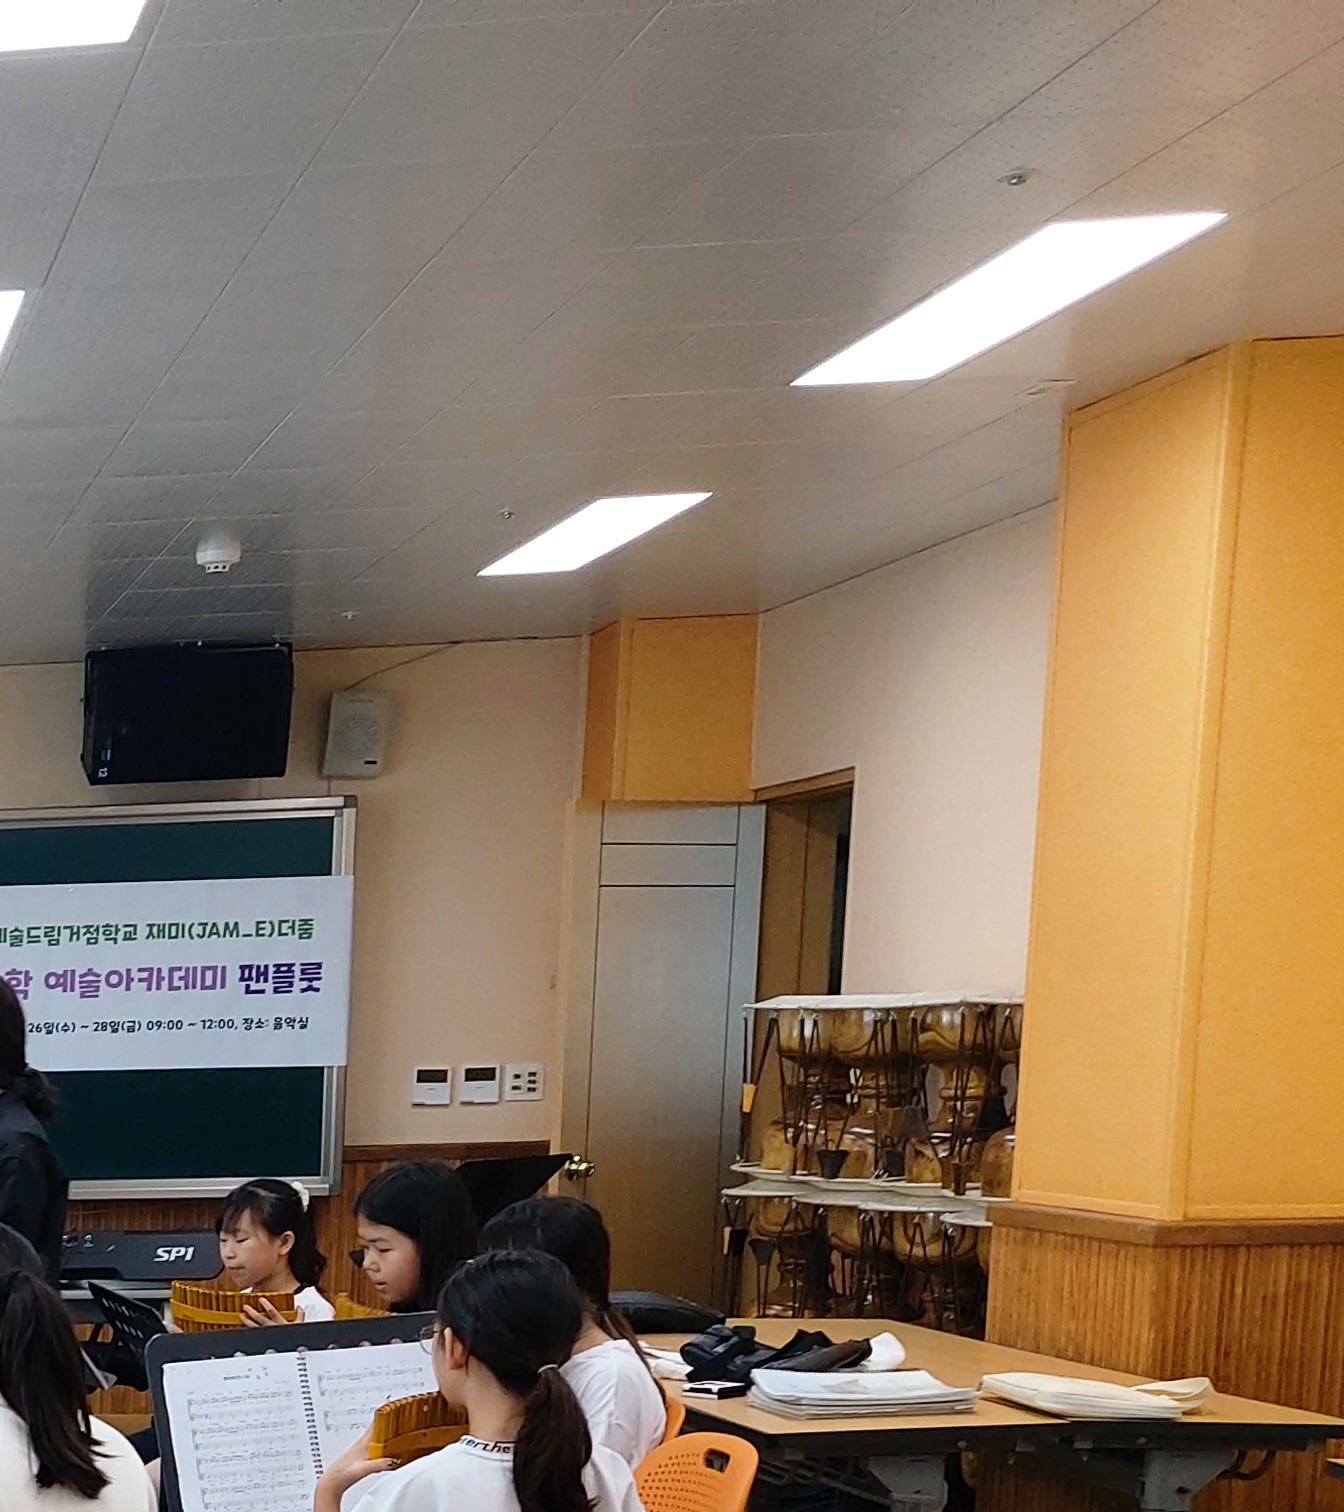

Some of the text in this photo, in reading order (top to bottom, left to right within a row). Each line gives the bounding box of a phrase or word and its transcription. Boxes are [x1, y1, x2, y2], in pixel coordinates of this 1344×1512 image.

[145, 917, 315, 941] 재미(JAM_E)더줌
[43, 965, 227, 999] 예술아카데미
[238, 961, 324, 995] 팬플룻
[27, 1022, 76, 1035] 26일(수)
[92, 1020, 142, 1034] 28일(금)
[146, 1020, 184, 1032] 09:00
[200, 1018, 238, 1031] 12:00,
[241, 1017, 270, 1031] 장소:
[272, 1016, 310, 1031] 음악실
[460, 1437, 511, 1455] erthe
